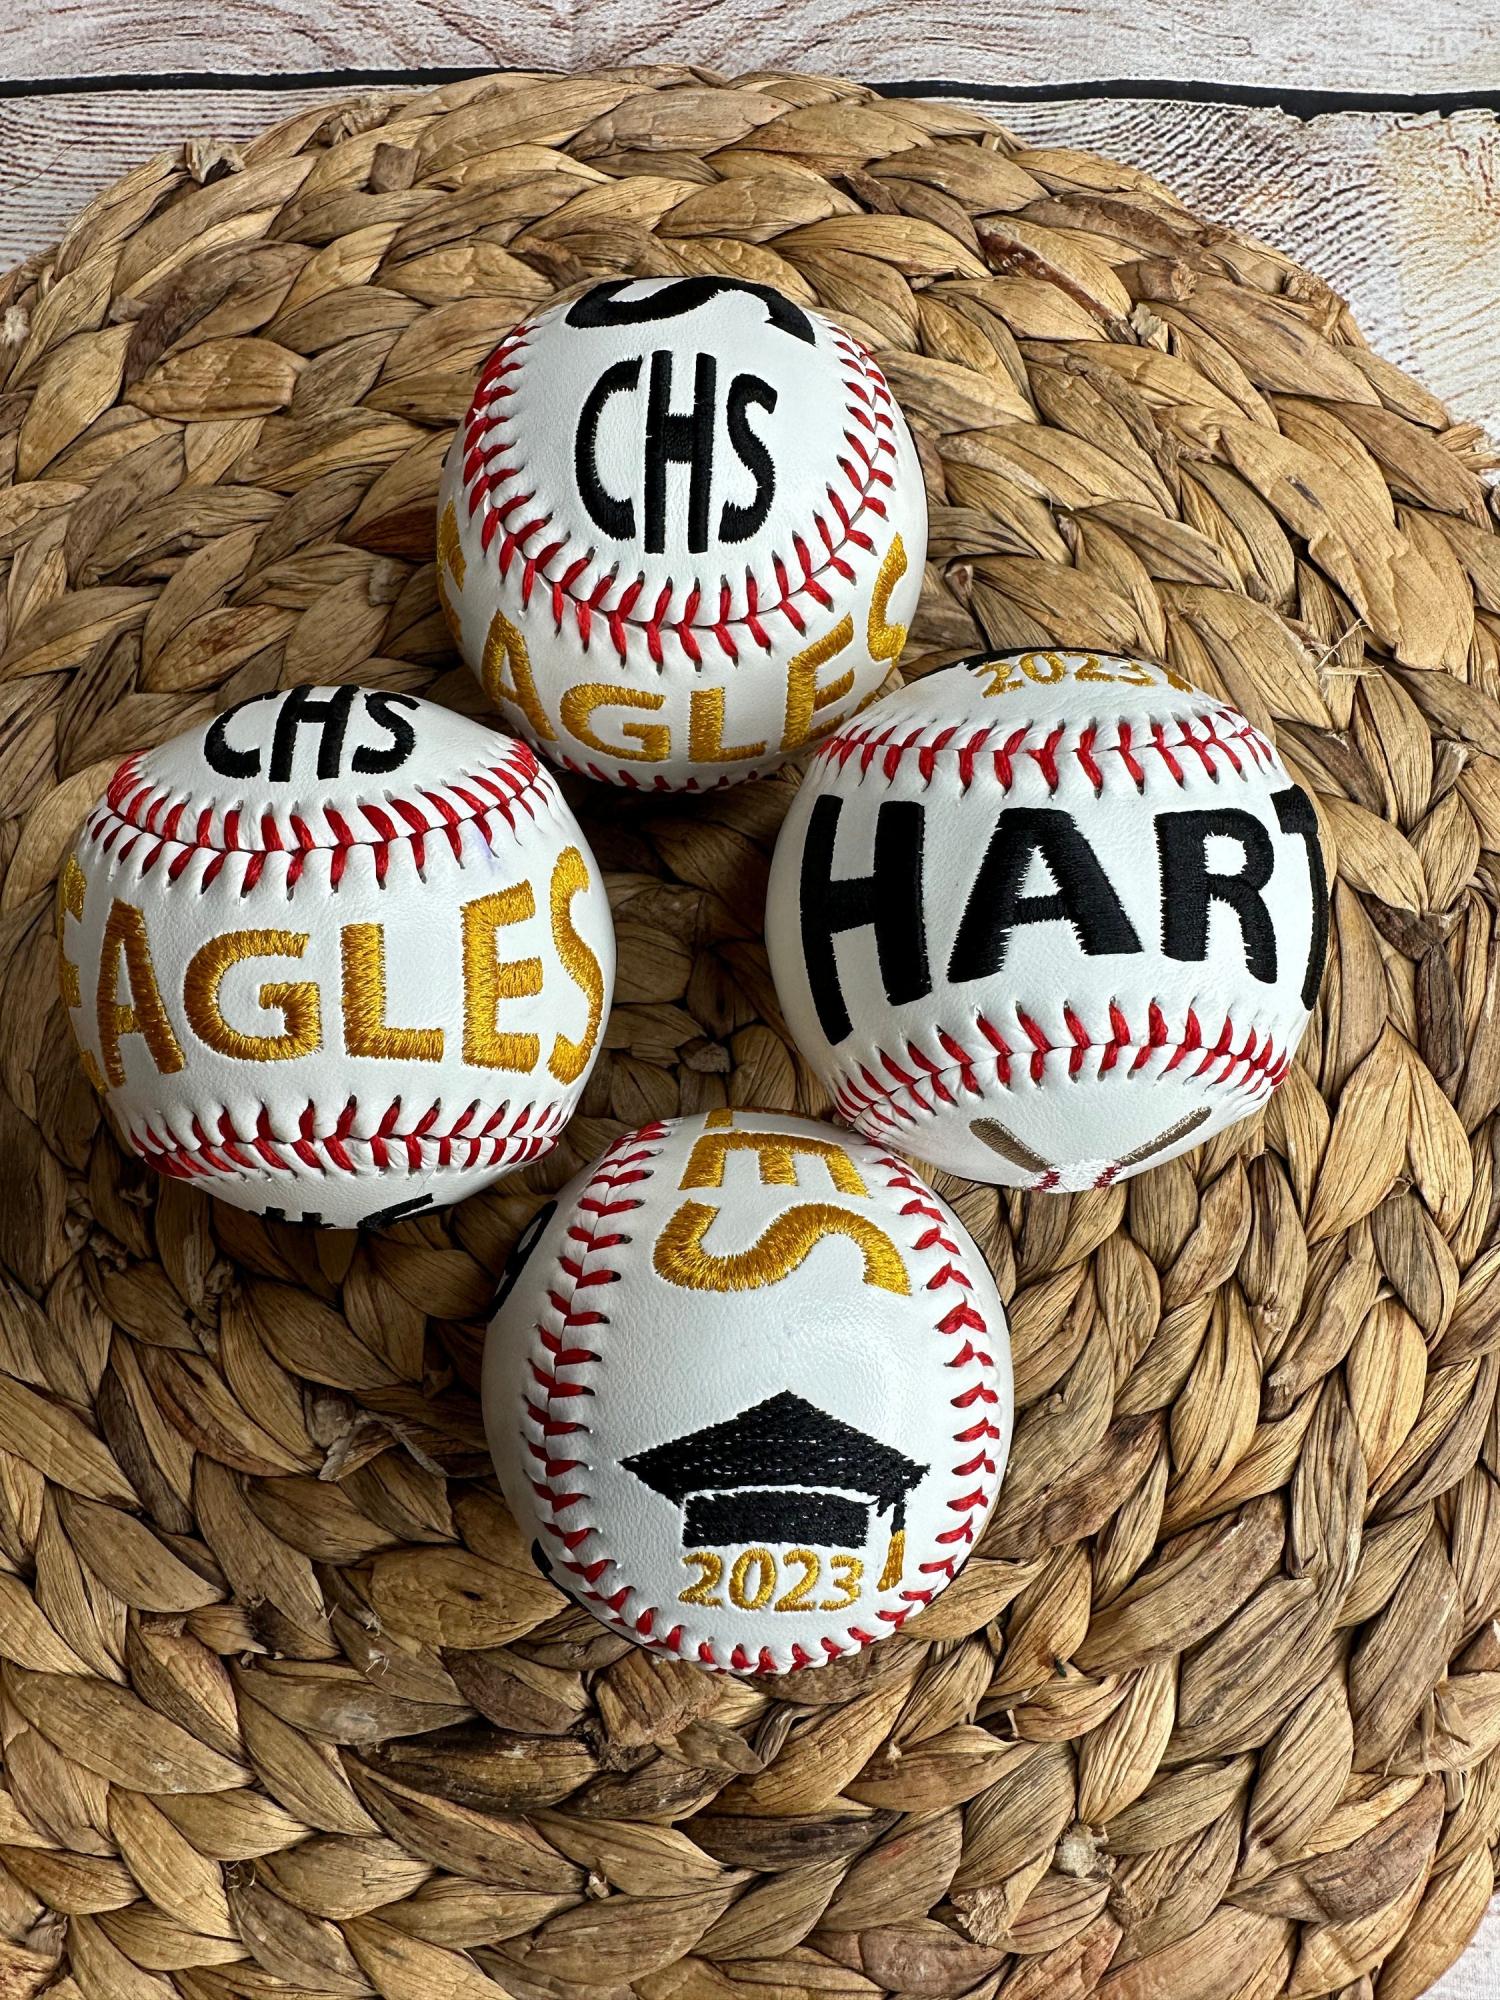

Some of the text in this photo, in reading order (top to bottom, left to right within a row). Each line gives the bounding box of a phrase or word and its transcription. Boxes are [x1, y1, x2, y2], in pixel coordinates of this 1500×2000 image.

[575, 350, 778, 554] CHS
[203, 684, 421, 782] CHS
[678, 1547, 865, 1613] 2023
